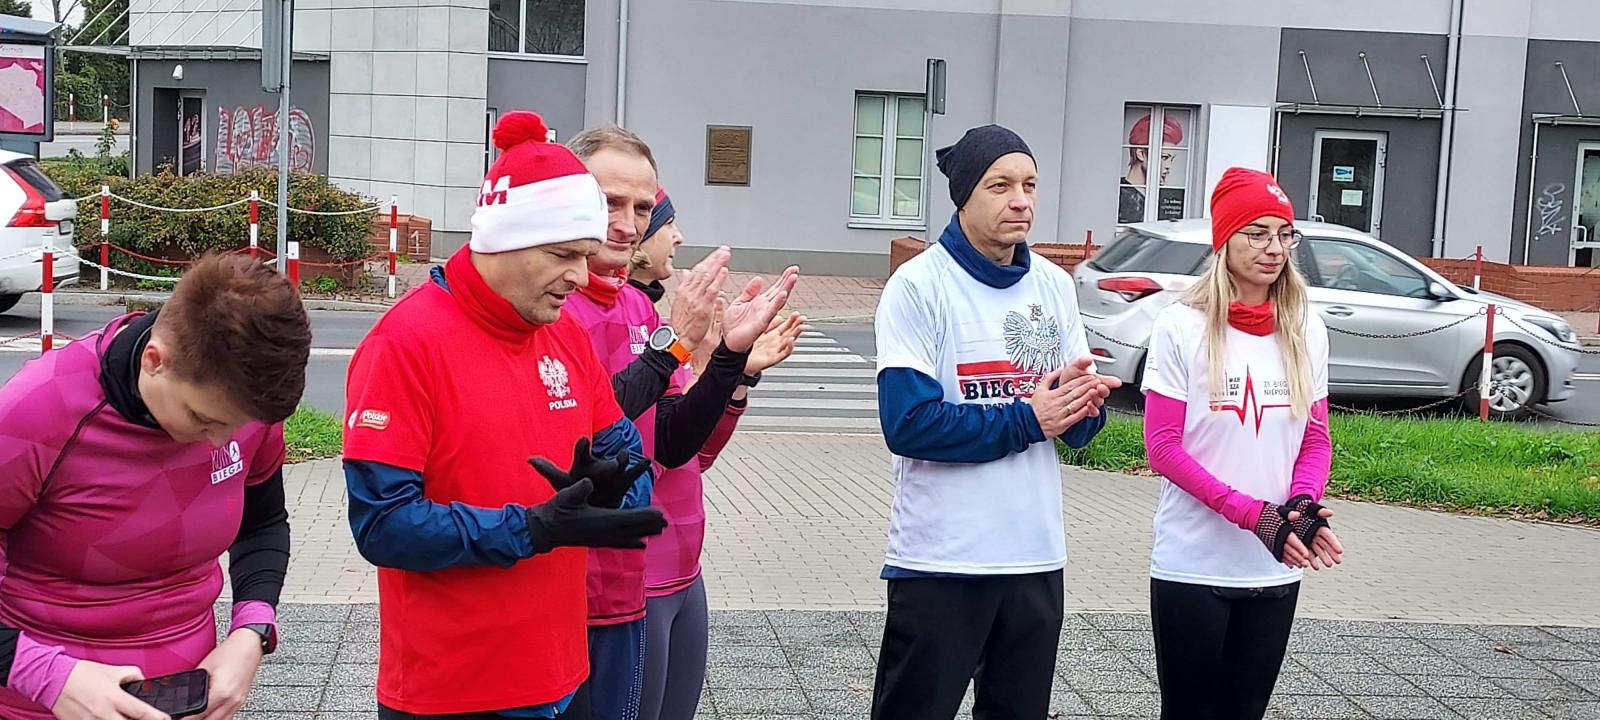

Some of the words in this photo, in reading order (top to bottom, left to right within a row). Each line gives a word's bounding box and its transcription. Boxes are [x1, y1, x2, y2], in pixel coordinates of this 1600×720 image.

[964, 379, 1016, 400] BIEG
[1263, 388, 1291, 397] NIEPOD
[548, 398, 578, 411] POLSKA
[212, 463, 242, 482] BIEGA
